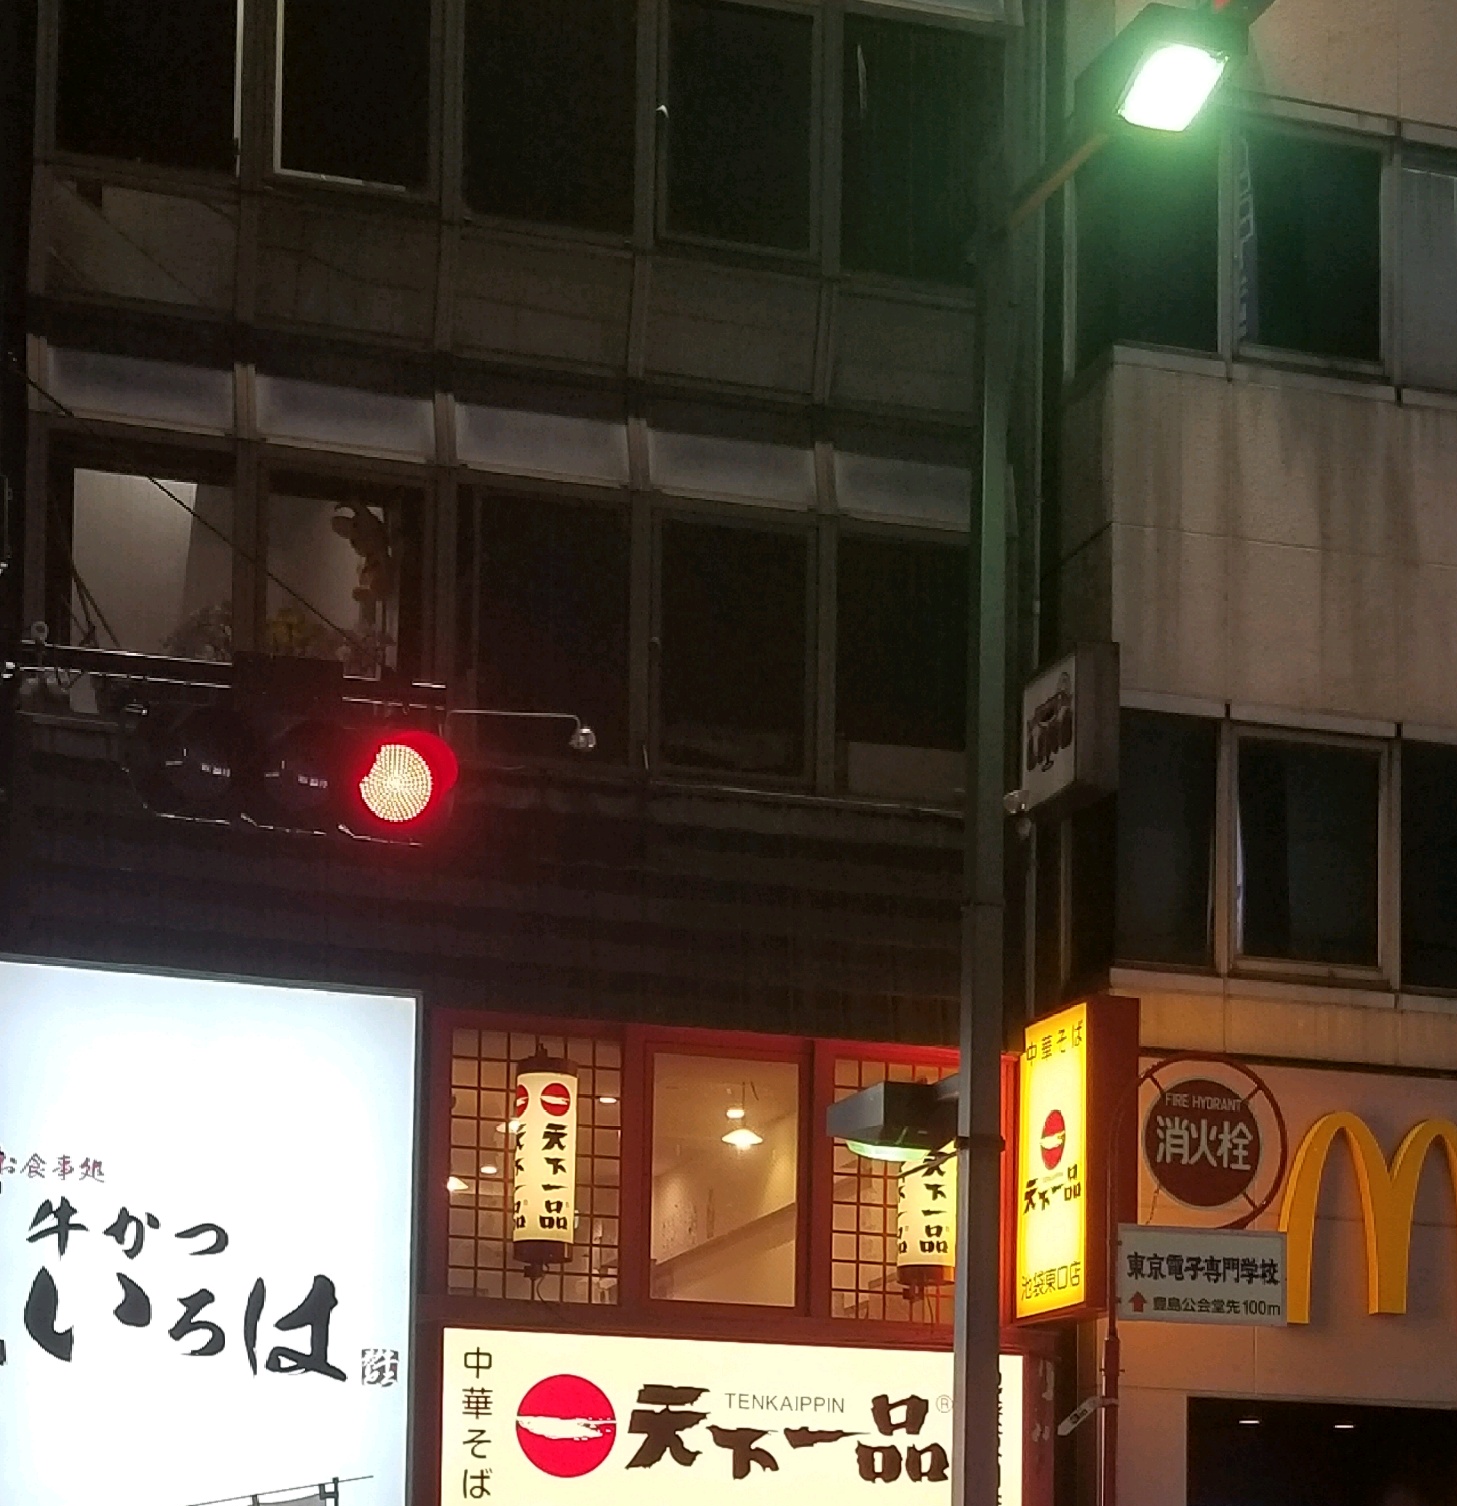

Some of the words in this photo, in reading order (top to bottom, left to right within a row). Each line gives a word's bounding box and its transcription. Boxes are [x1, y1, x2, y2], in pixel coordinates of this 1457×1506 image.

[1026, 1019, 1083, 1065] 中華そば
[1165, 1092, 1188, 1110] FIRE
[1193, 1095, 1242, 1113] HYDRANT
[1156, 1115, 1253, 1172] 消火栓
[541, 1123, 569, 1231] 天下一品
[1023, 1163, 1083, 1214] 天下一品
[26, 1197, 230, 1259] 牛かつ
[1021, 1260, 1082, 1301] 池袋東口店
[1127, 1252, 1281, 1286] 東京電子専門学校
[24, 1265, 347, 1382] いろは
[462, 1346, 494, 1499] 中華そば
[725, 1391, 846, 1414] TENKAIPPIN
[625, 1383, 950, 1484] 天下一品
